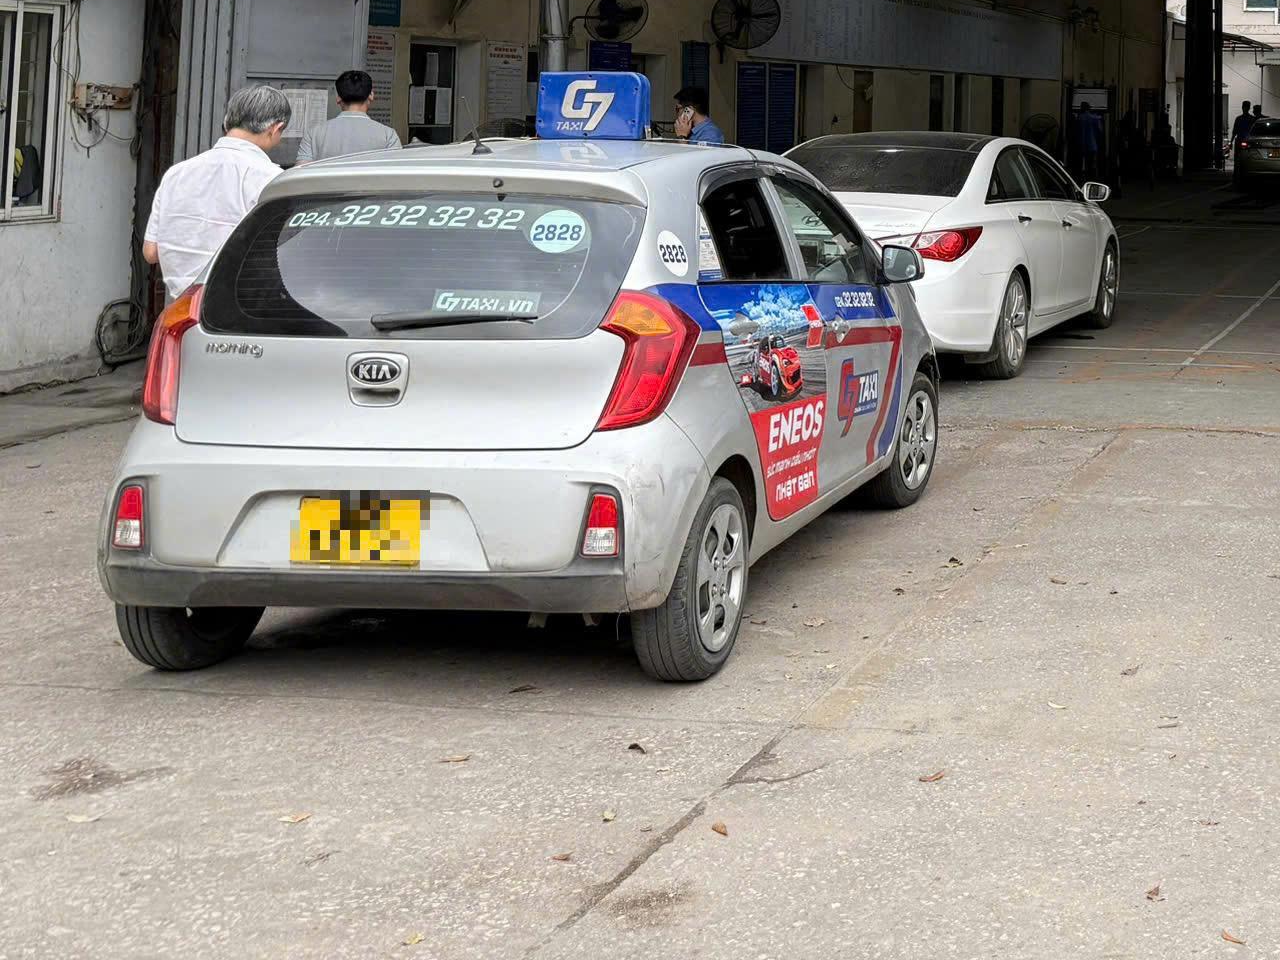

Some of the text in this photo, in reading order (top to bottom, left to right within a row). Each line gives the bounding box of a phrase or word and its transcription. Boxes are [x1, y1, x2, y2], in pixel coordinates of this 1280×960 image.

[561, 80, 615, 131] G7
[555, 121, 585, 131] TAXI
[532, 223, 583, 242] 2828
[659, 244, 687, 263] 2828
[205, 341, 264, 359] morning
[357, 363, 393, 380] KIA
[859, 373, 877, 403] TAXI
[768, 401, 824, 453] ENEOS
